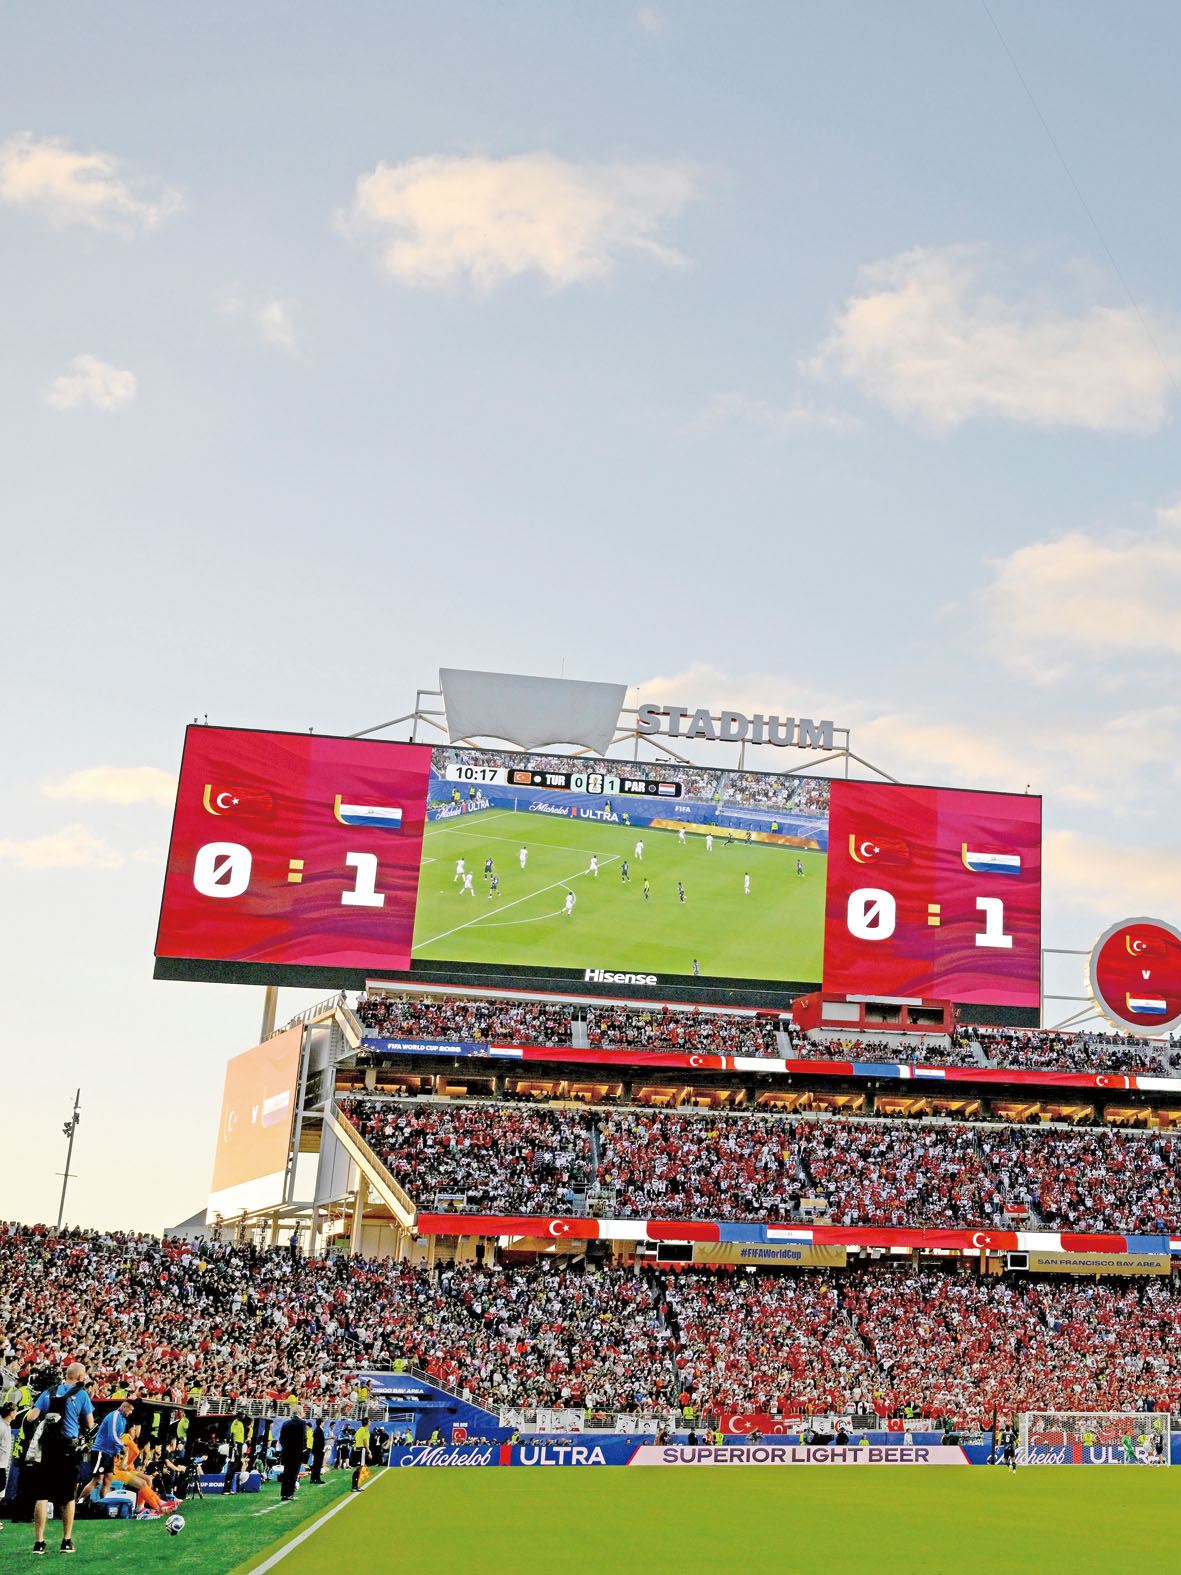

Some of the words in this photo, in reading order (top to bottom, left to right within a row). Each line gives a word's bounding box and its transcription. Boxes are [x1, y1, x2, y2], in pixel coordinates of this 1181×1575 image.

[638, 703, 834, 750] STADIUM
[456, 767, 498, 782] 10:17
[546, 774, 566, 786] TUR
[574, 777, 583, 788] 0
[608, 780, 615, 791] 1
[624, 780, 646, 793] PAR
[468, 798, 490, 813] ULTRA
[529, 801, 570, 815] Michelob
[580, 808, 619, 822] ULTRA
[674, 805, 691, 813] FIFA
[193, 841, 252, 898] 0
[341, 852, 385, 907] 1
[847, 888, 896, 940] 0
[975, 897, 1013, 948] 1
[584, 968, 658, 985] Hisense
[741, 1248, 801, 1260] #FIFAWorldCup
[1059, 1259, 1114, 1267] FRANCISCO
[400, 1445, 492, 1466] Michelob
[519, 1446, 606, 1465] ULTRA
[662, 1448, 786, 1463] SUPERIOR
[791, 1448, 863, 1463] LIGHT
[868, 1448, 929, 1463] BEER
[1090, 1447, 1165, 1464] ULTR
